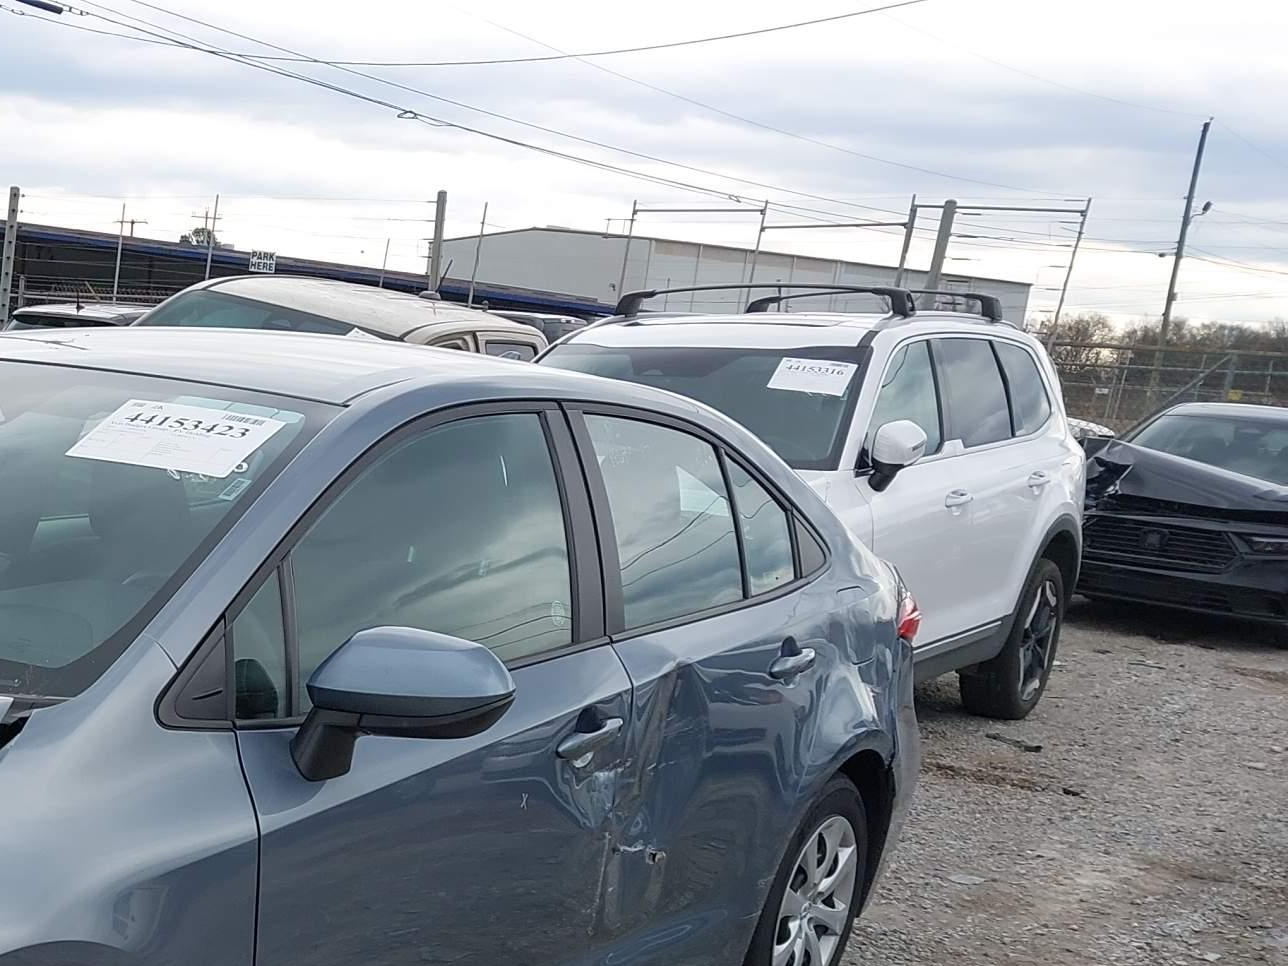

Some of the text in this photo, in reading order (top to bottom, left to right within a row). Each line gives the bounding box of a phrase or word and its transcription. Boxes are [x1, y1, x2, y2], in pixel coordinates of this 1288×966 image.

[251, 250, 276, 261] PARK
[250, 260, 274, 271] HERE
[786, 364, 844, 376] 44153316
[124, 412, 251, 440] 44153423
